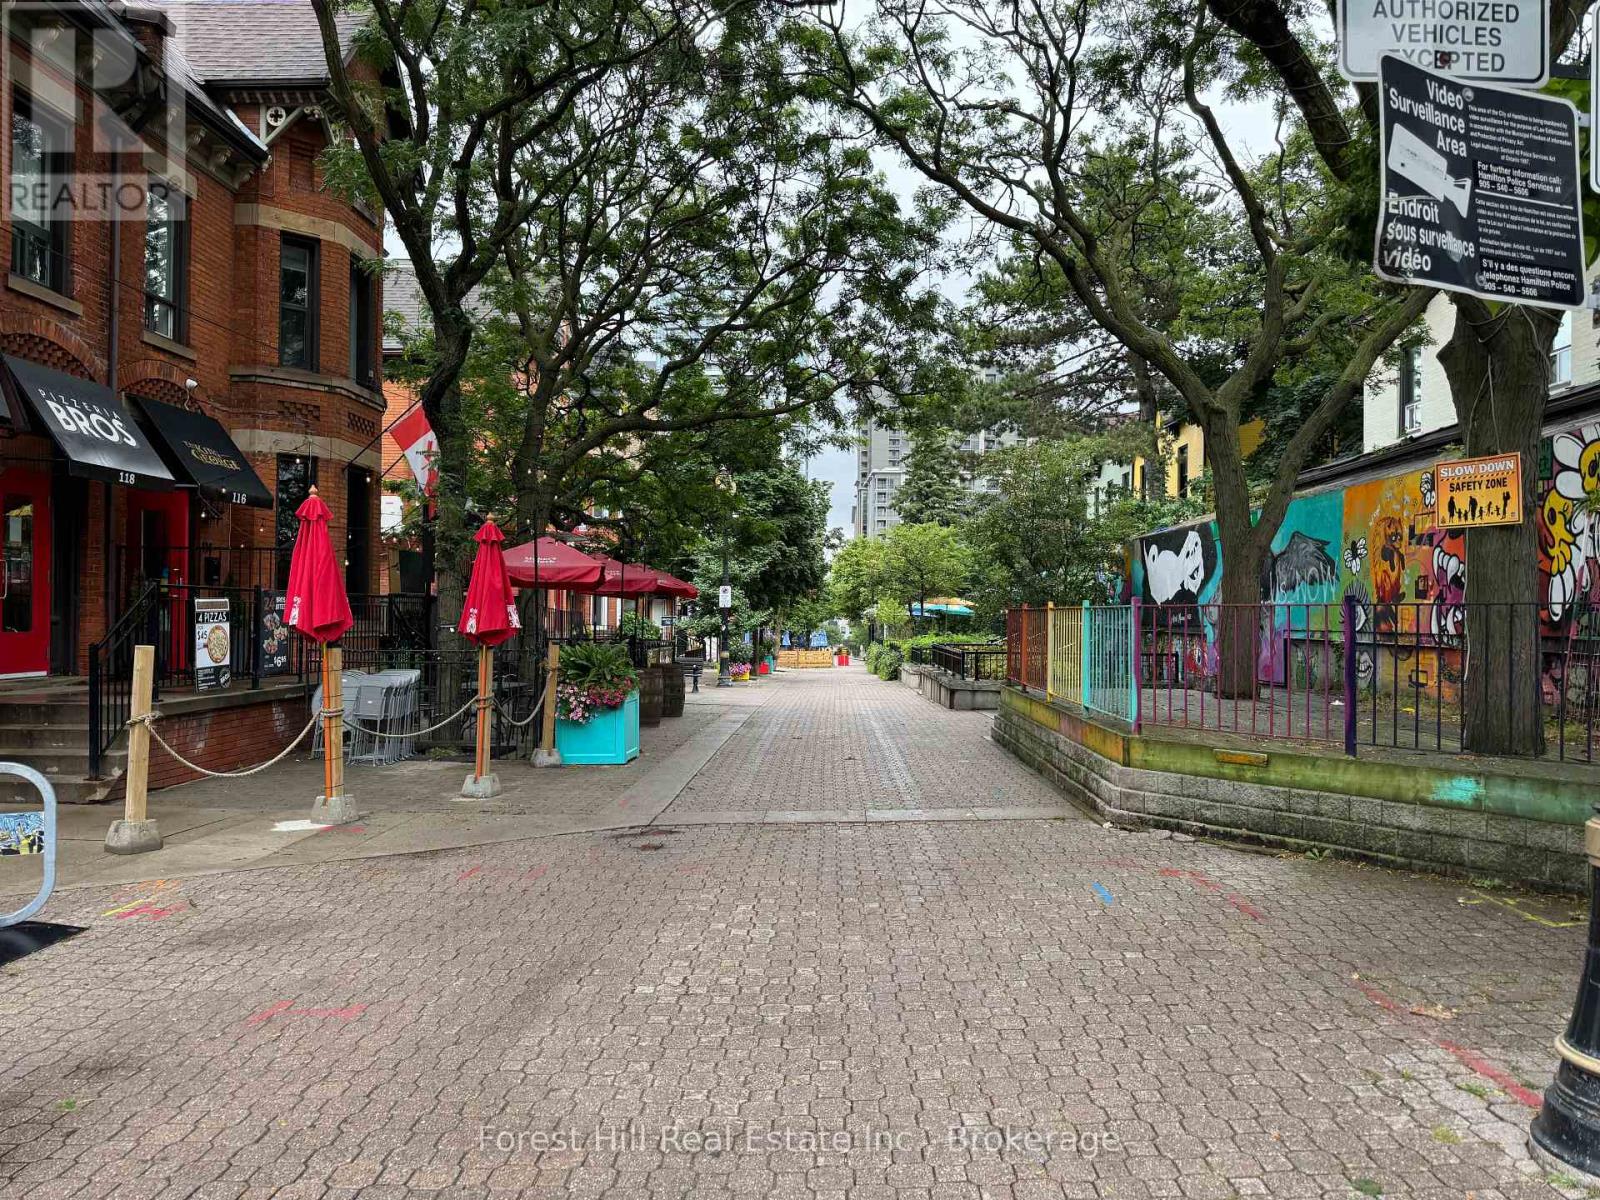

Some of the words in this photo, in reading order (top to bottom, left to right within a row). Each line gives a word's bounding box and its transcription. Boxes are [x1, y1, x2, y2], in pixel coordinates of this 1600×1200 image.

[1372, 0, 1520, 23] AUTHORIZED
[1392, 23, 1502, 47] VEHICLES
[1426, 79, 1464, 110] Video
[1389, 87, 1465, 134] Surveillance
[1436, 129, 1467, 158] Area
[1477, 161, 1488, 171] For
[1490, 164, 1512, 175] further
[1478, 170, 1506, 183] Hamilton
[1506, 176, 1526, 187] Police
[1526, 180, 1554, 192] Services
[1554, 186, 1561, 194] at
[1388, 191, 1440, 224] Endroit
[1386, 222, 1417, 242] sous
[1419, 228, 1475, 258] surveillance
[1383, 246, 1431, 271] vidéo
[1494, 262, 1499, 271] y
[1506, 263, 1519, 272] des
[1519, 265, 1552, 278] questions
[1520, 276, 1550, 288] Hamilton
[1550, 280, 1571, 291] Police
[46, 399, 137, 447] BROS
[119, 471, 135, 484] 118
[1440, 465, 1476, 478] SLOW
[1479, 460, 1514, 473] DOWN
[1449, 480, 1483, 493] SAFETY
[1485, 477, 1508, 490] ZONE
[232, 492, 248, 504] 116
[204, 611, 227, 623] PIZZAS
